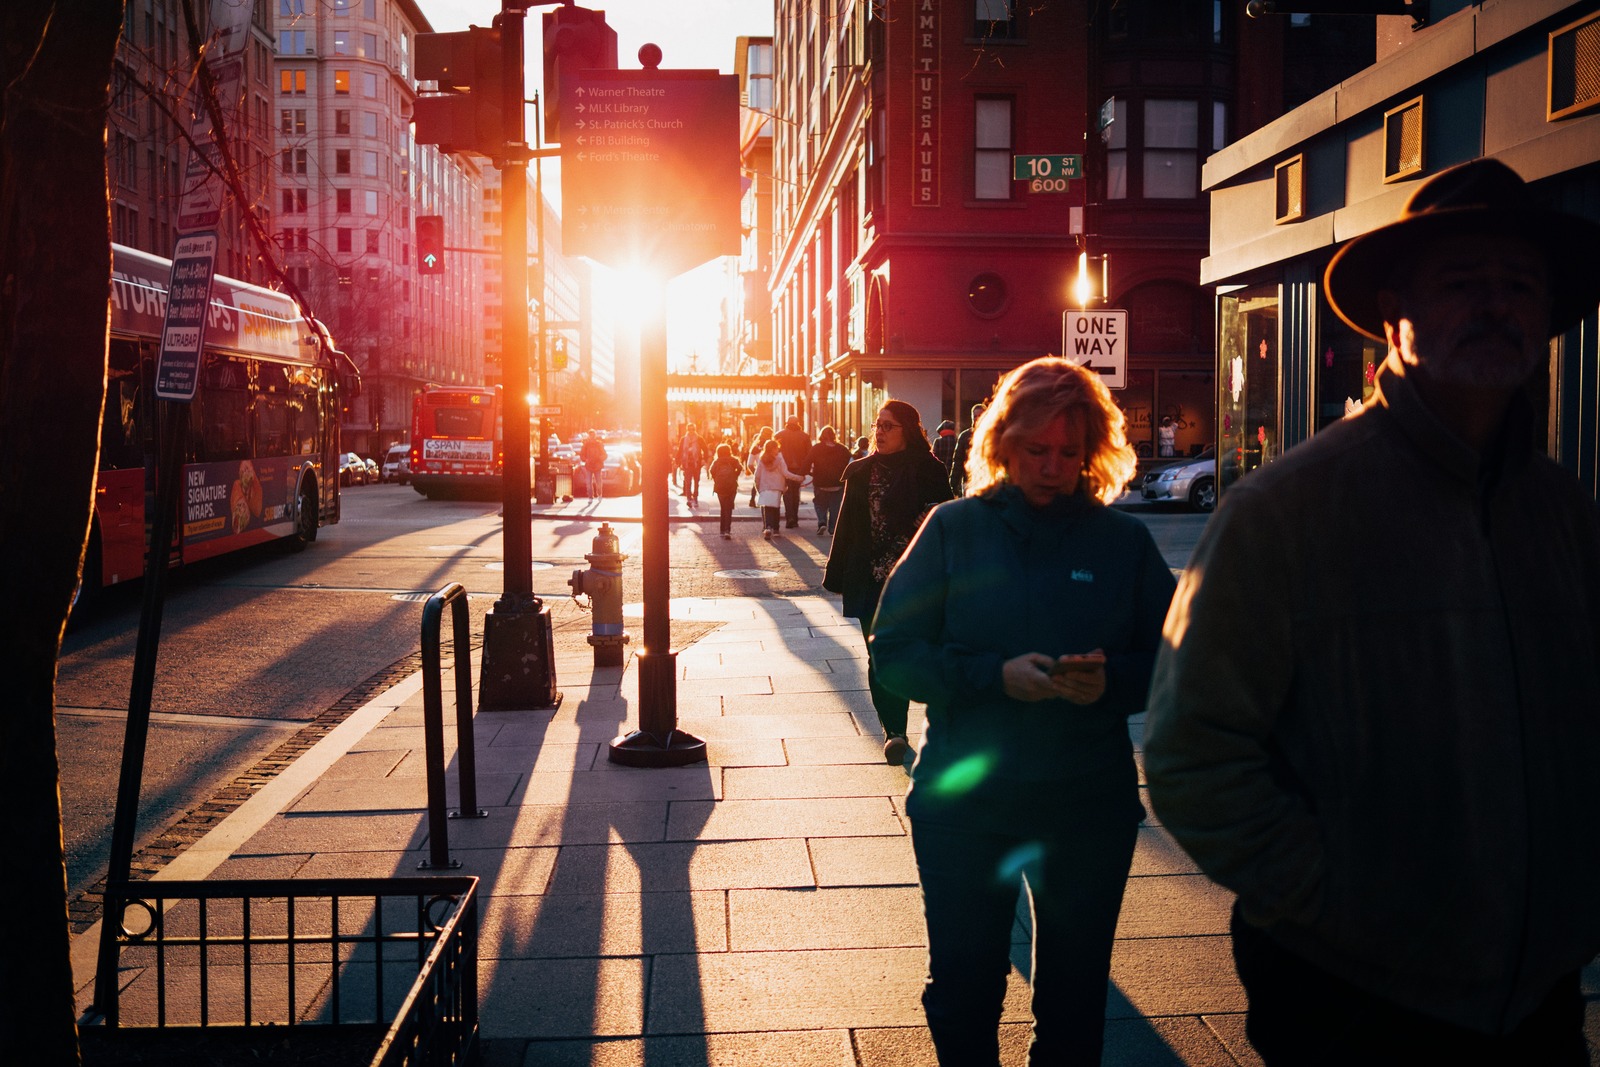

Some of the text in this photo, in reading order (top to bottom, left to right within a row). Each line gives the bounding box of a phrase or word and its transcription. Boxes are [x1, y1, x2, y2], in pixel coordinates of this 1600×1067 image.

[588, 87, 665, 97] Warner Theatre
[919, 0, 934, 201] AME TUSSAUDS
[589, 103, 649, 115] MLK Library
[589, 119, 683, 130] St. Patrick's Church
[589, 135, 650, 147] FBI Building
[589, 151, 660, 162] Ford's Theatre
[1062, 157, 1075, 166] ST
[1027, 157, 1052, 177] 10
[1061, 167, 1075, 176] NW
[1032, 179, 1066, 192] 600
[175, 263, 208, 281] Adopt-A-Block
[111, 271, 169, 318] ATURE
[172, 284, 207, 299] This Block Has
[169, 302, 204, 322] Been Adopted By
[1076, 316, 1117, 334] ONE
[166, 333, 197, 348] ULTRABAR
[1074, 337, 1118, 355] WAY
[471, 395, 480, 404] 42
[425, 440, 462, 450] C-SPAN
[188, 471, 205, 487] NEW
[188, 485, 226, 504] SIGNATURE
[188, 503, 215, 521] WRAPS.
[264, 504, 285, 521] SUBWAY
